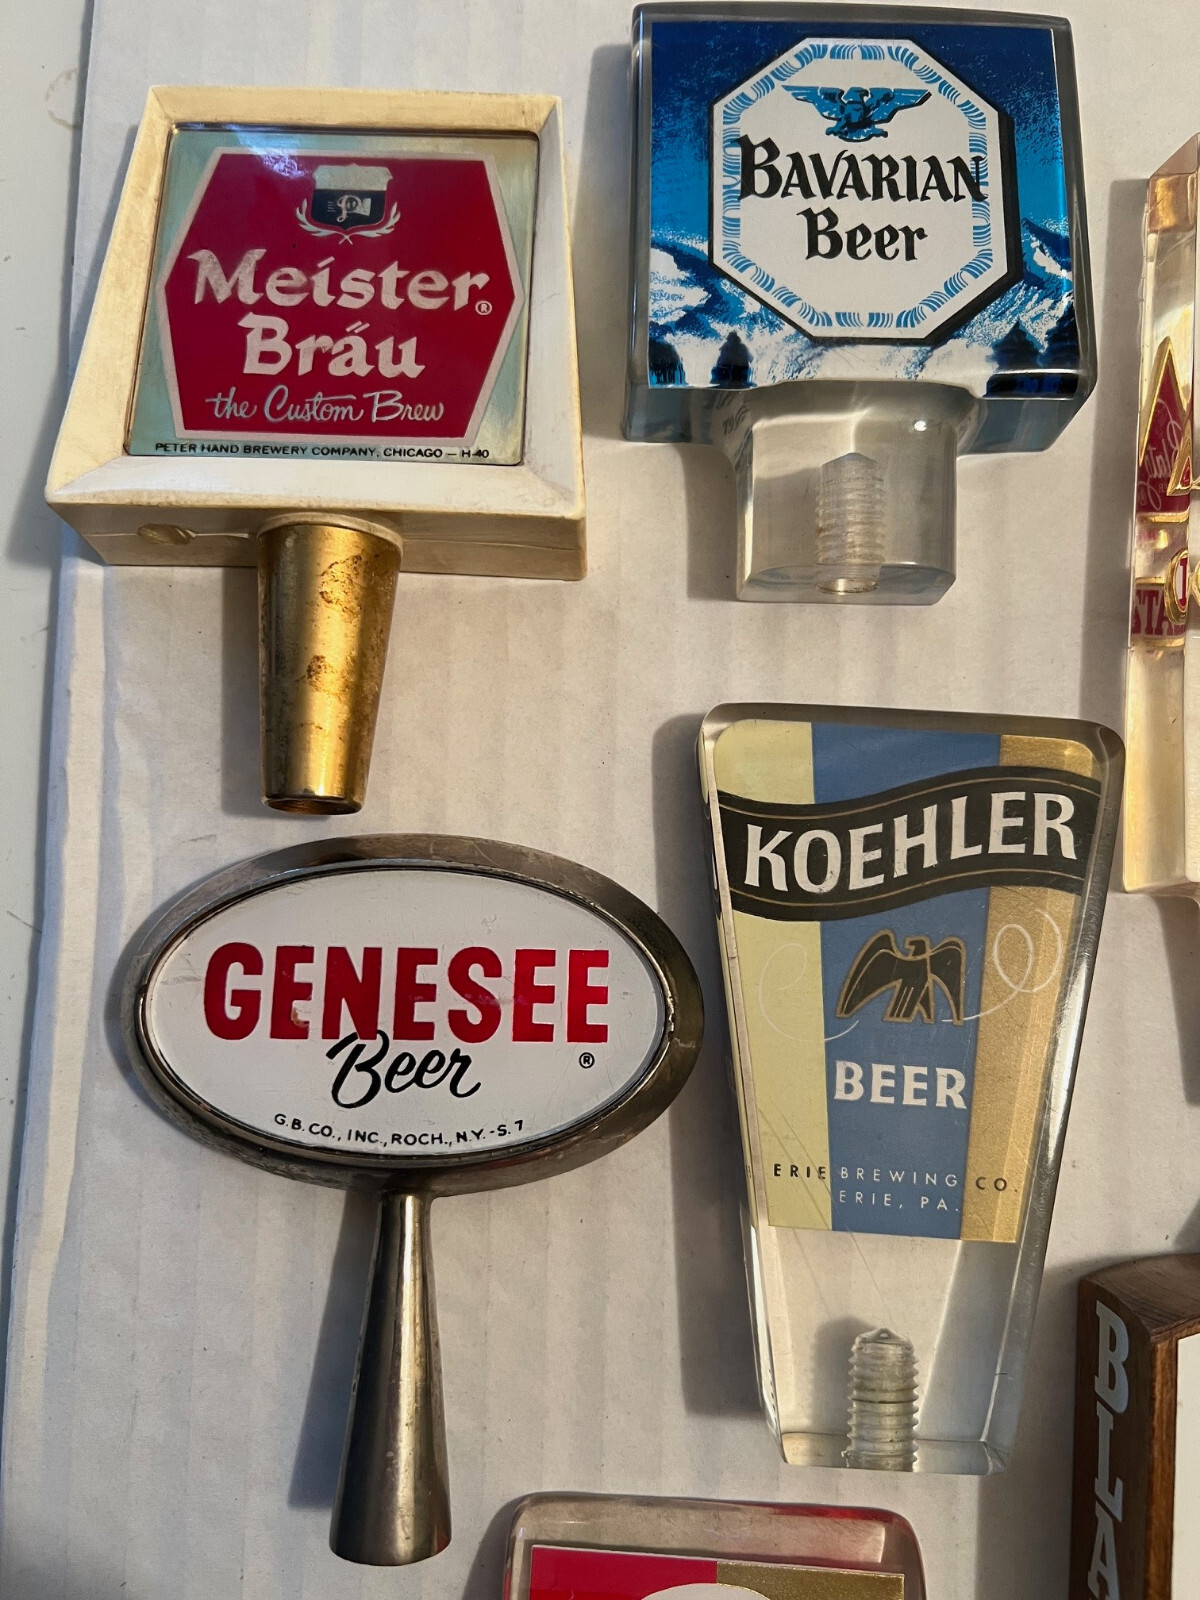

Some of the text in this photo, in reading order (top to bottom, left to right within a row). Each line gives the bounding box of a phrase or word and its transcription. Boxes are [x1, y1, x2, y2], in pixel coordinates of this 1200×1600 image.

[735, 133, 989, 203] BAVARIAN
[796, 207, 928, 262] Beer
[187, 248, 490, 312] Meister
[237, 311, 426, 379] Bräu
[205, 384, 445, 423] the Custom Brew
[155, 442, 198, 454] PETER
[201, 443, 240, 454] HAND
[243, 444, 308, 455] BREWERY
[311, 446, 379, 459] COMPANY,
[383, 448, 443, 459] CHICAGO
[743, 791, 1078, 894] KOEHLER
[203, 941, 610, 1044] GENESEE
[325, 1030, 482, 1109] Beer
[833, 1060, 968, 1110] BEER
[773, 1163, 1019, 1192] ERIE BREWING CO.
[839, 1190, 959, 1212] ERIE, PA.
[1087, 1300, 1129, 1600] BLA
